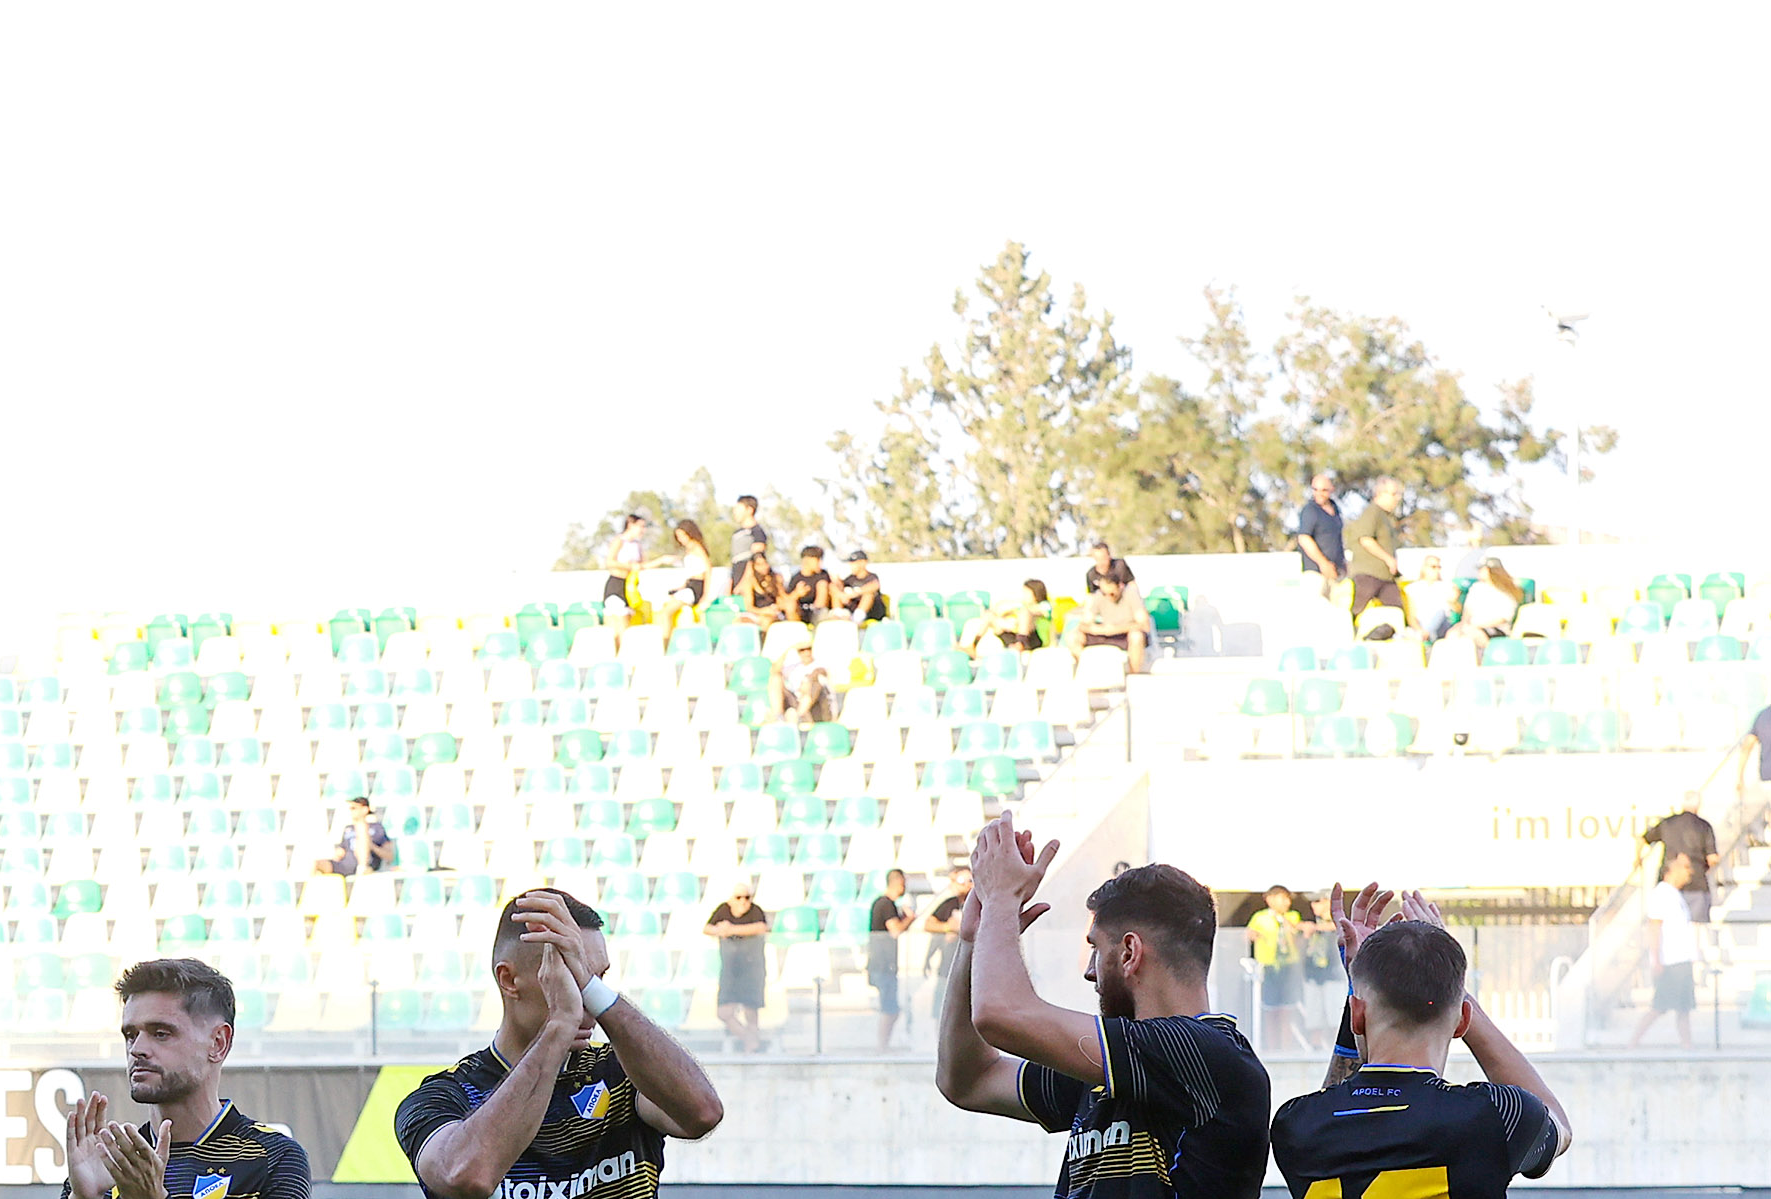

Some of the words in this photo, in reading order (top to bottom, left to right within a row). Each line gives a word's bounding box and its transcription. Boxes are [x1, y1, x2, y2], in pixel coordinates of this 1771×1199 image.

[1492, 804, 1551, 840] i'm
[1351, 1087, 1384, 1097] APOEL
[1386, 1088, 1402, 1097] FC
